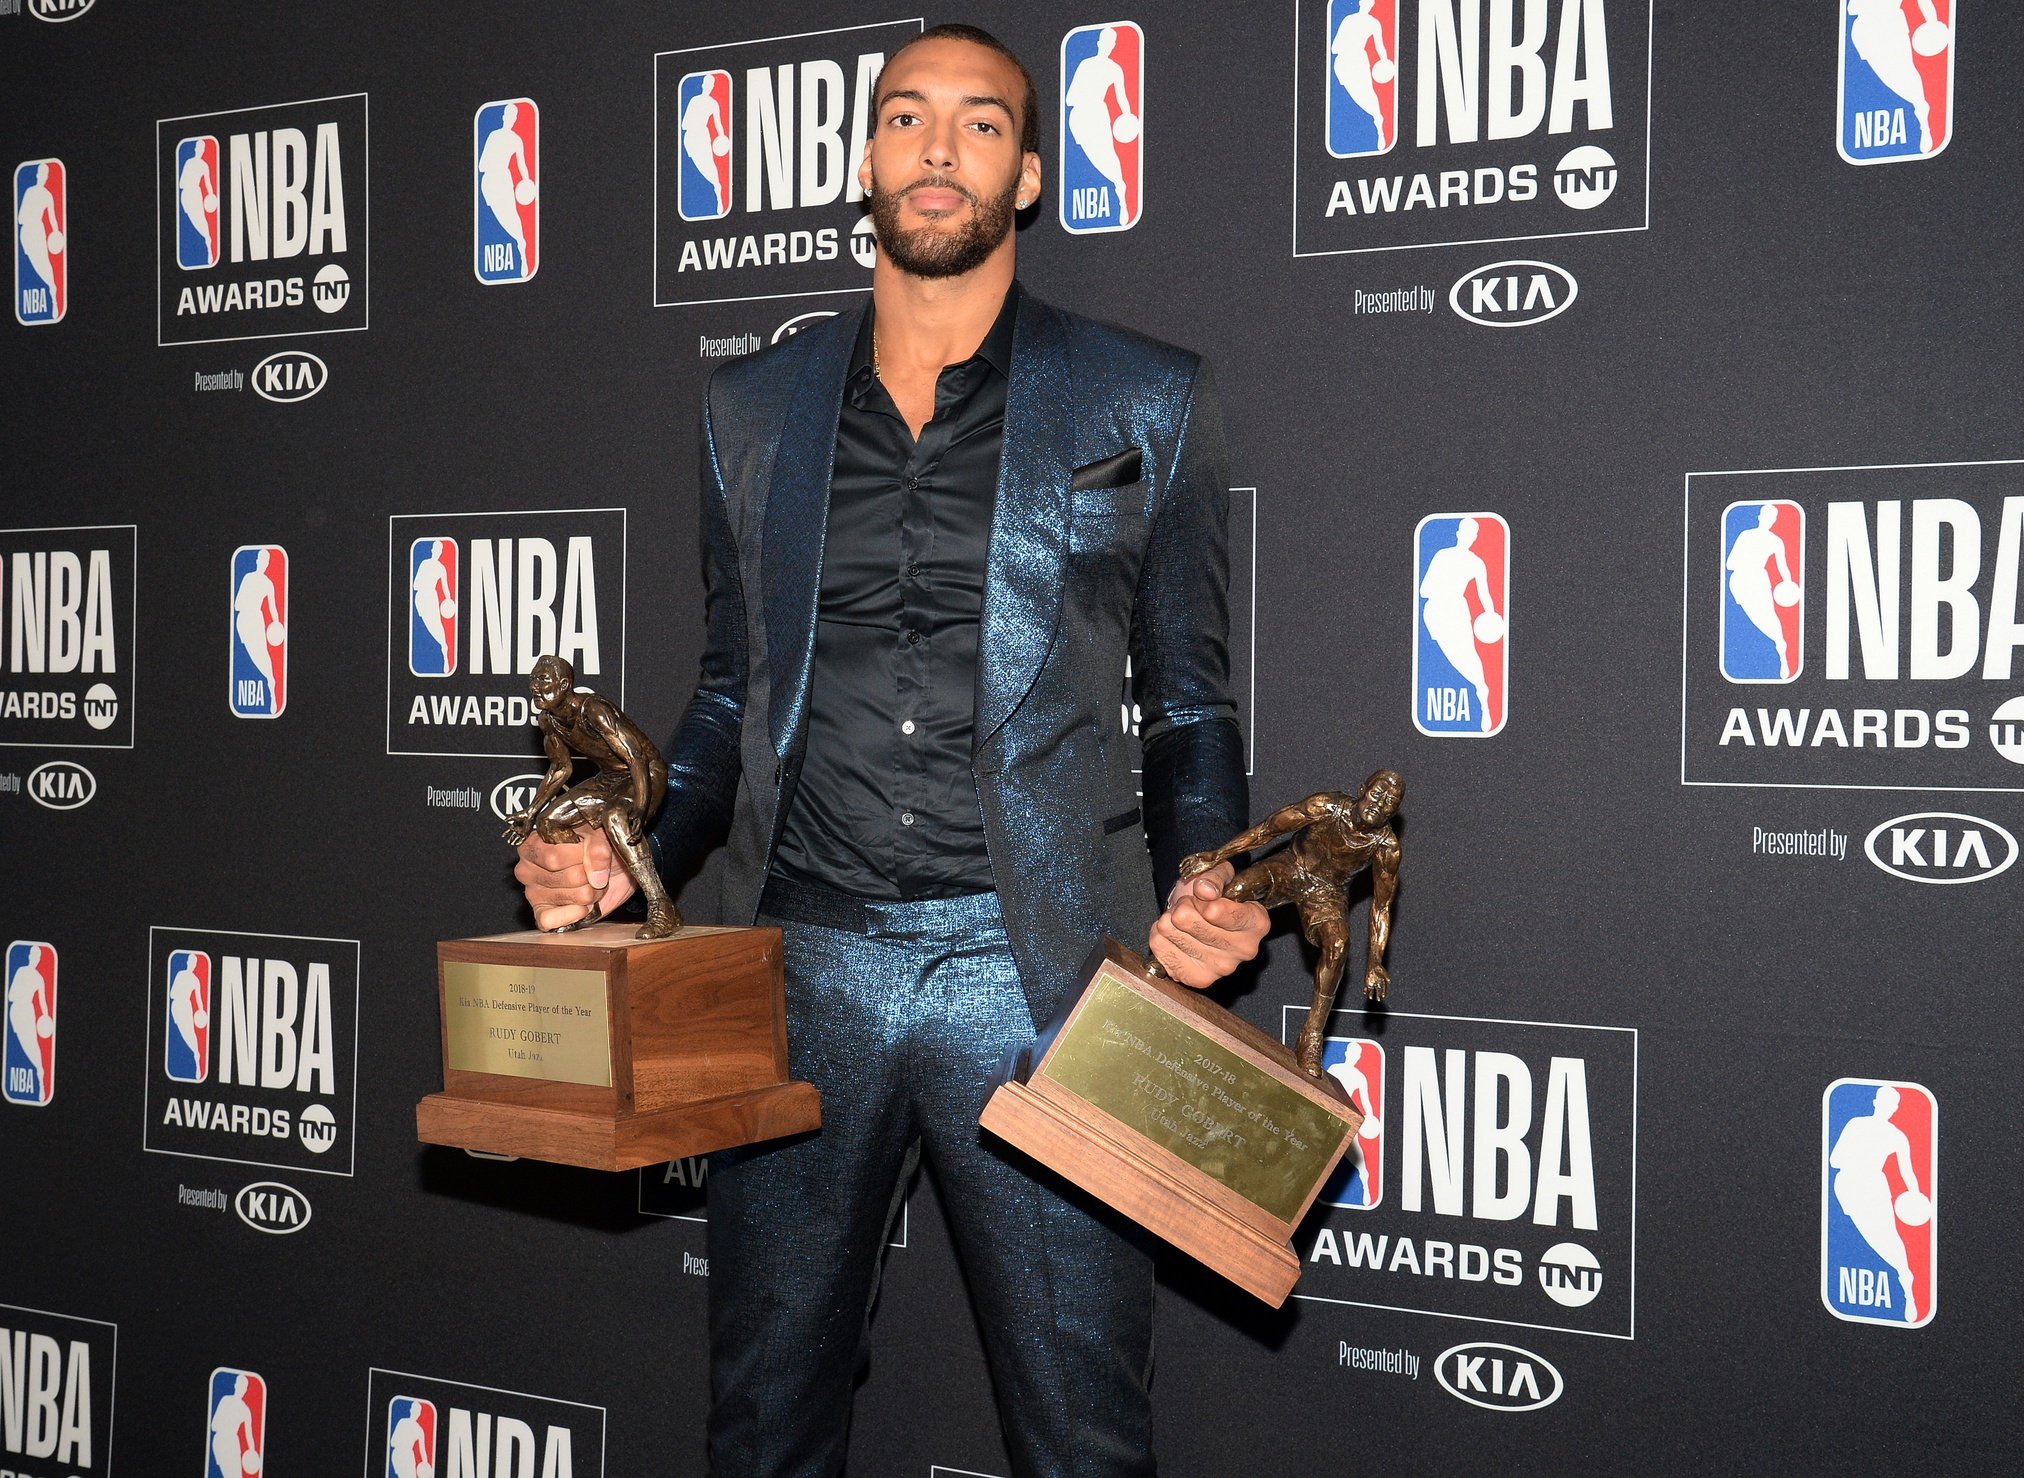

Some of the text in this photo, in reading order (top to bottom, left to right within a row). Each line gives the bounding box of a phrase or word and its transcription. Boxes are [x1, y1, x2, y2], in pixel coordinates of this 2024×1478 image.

[1417, 0, 1613, 147] NBA
[1855, 108, 1906, 149] NBA
[230, 122, 347, 264] NBA
[1073, 186, 1110, 220] NBA
[1325, 164, 1538, 218] AWARDS
[485, 243, 514, 272] NBA
[677, 228, 839, 273] AWARDS
[23, 287, 47, 315] NBA
[177, 277, 304, 316] AWARDS
[1355, 274, 1555, 315] Presented by KIA
[700, 333, 748, 358] Presented
[194, 362, 315, 393] Presented by KIA
[11, 549, 116, 674] NBA
[470, 536, 600, 675] NBA
[0, 691, 76, 719] ARDS
[238, 679, 265, 707] NBA
[1427, 687, 1471, 722] NBA
[1718, 707, 1970, 749] AWARDS
[39, 771, 85, 799] KIA
[427, 785, 470, 809] Presented
[471, 786, 482, 812] by
[1753, 826, 1992, 869] Presented by KIA
[473, 998, 489, 1009] NBA
[492, 1000, 526, 1012] Defensive
[528, 1002, 550, 1014] Player
[551, 1005, 559, 1015] of
[561, 1005, 573, 1016] the
[574, 1006, 592, 1017] Year
[509, 983, 536, 994] 2018-19
[219, 956, 334, 1094] NBA
[489, 1027, 561, 1045] RUDY GOBERT
[508, 1048, 526, 1060] Utah
[1193, 1054, 1236, 1085] 2017-18
[10, 1066, 34, 1095] NBA
[1124, 1030, 1152, 1057] NBA
[1155, 1051, 1209, 1092] Defensive
[1211, 1085, 1247, 1114] Player
[1247, 1110, 1261, 1123] of
[1262, 1115, 1280, 1135] the
[1285, 1127, 1309, 1151] Year
[1132, 1072, 1179, 1106] RUDY
[163, 1097, 290, 1139] AWARDS
[1150, 1107, 1178, 1134] Utah
[1402, 1045, 1598, 1231] NBA
[178, 1183, 299, 1225] Presented by KIA
[1309, 1228, 1523, 1286] AWARDS
[1839, 1266, 1891, 1309] NBA
[1339, 1340, 1541, 1400] Presented by KIA
[0, 1327, 92, 1469] NBA
